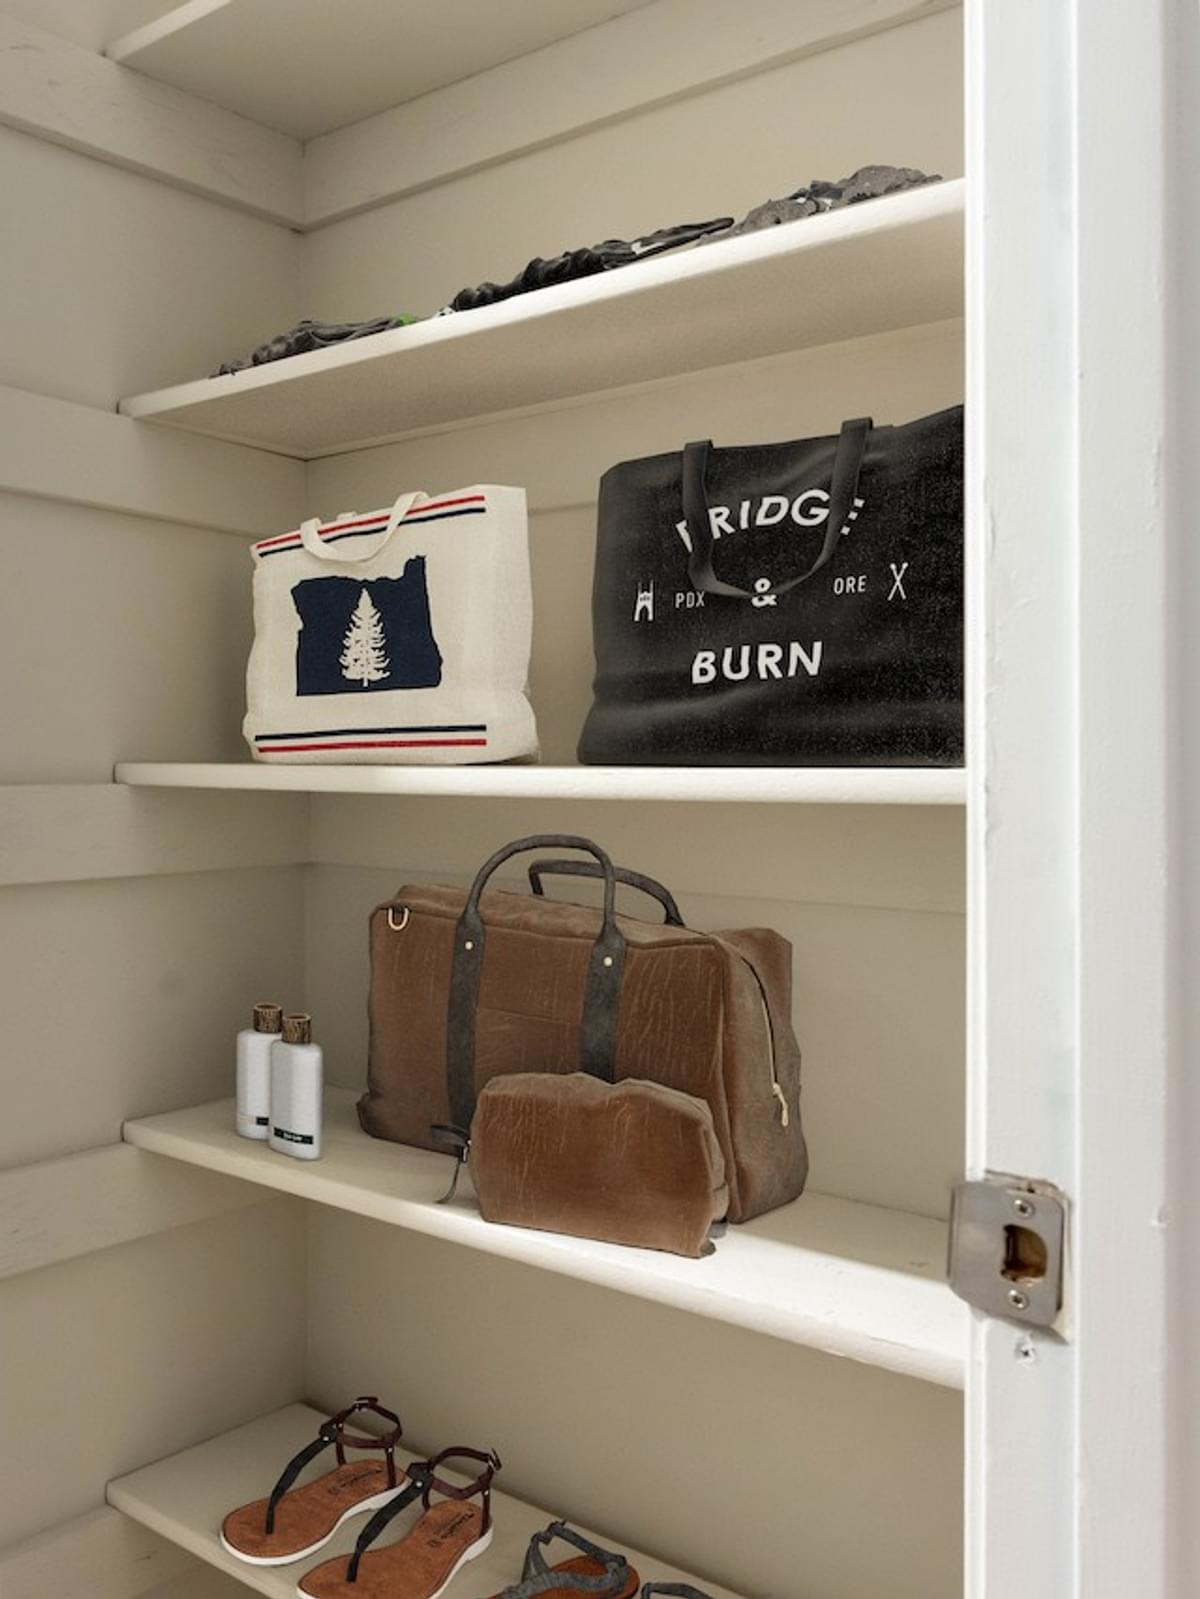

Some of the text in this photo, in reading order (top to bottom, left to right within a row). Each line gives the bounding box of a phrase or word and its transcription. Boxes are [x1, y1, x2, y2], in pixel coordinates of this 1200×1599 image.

[674, 575, 867, 609] PDX & ORE
[691, 640, 823, 685] BURN
